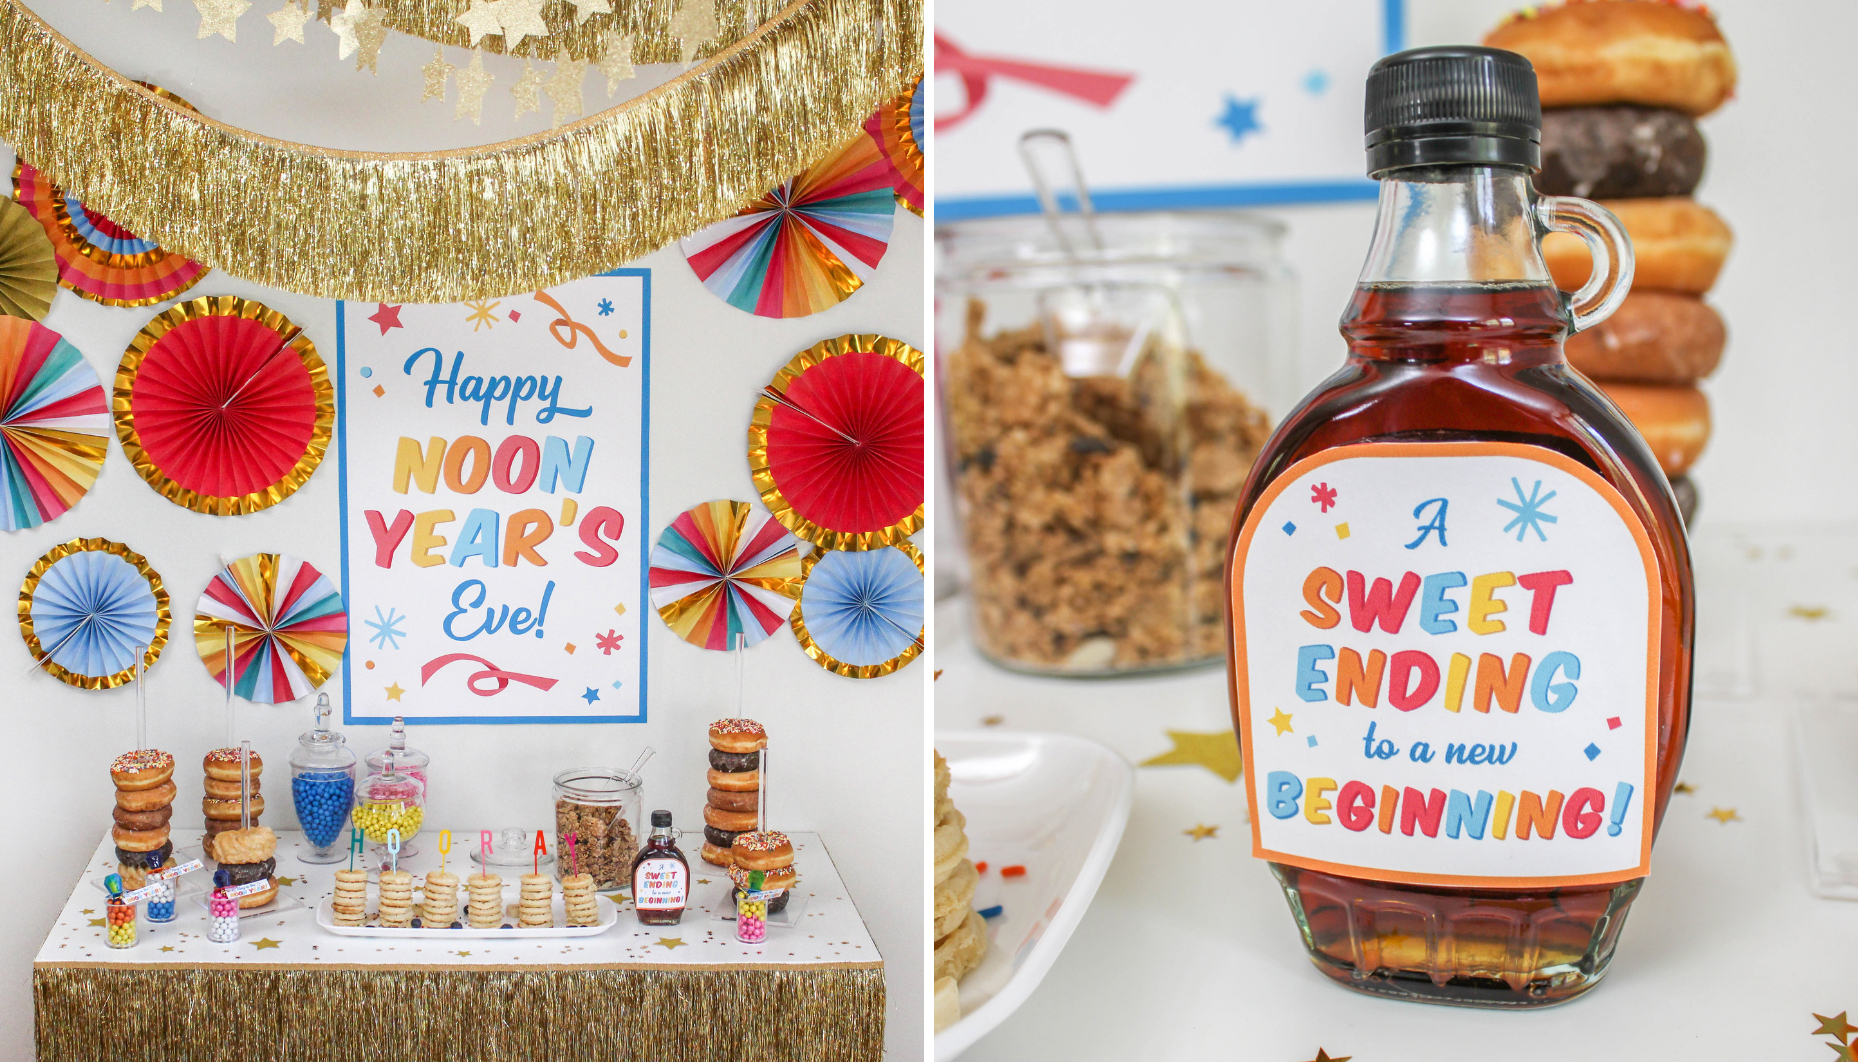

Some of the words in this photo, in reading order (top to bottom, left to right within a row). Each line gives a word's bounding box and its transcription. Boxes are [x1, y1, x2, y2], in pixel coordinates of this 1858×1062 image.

[403, 347, 593, 426] Happy
[392, 435, 594, 494] NOON
[364, 497, 625, 569] YEAR'S
[1404, 498, 1449, 550] A
[442, 578, 556, 642] Eve!
[1299, 566, 1573, 636] SWEET
[1295, 643, 1581, 714] ENDING
[1362, 721, 1400, 760] to
[1408, 741, 1436, 763] a
[1445, 741, 1518, 765] new
[1266, 770, 1634, 841] BEGINNING!
[638, 895, 684, 904] BEGINNING!
[645, 871, 677, 879] SWEET
